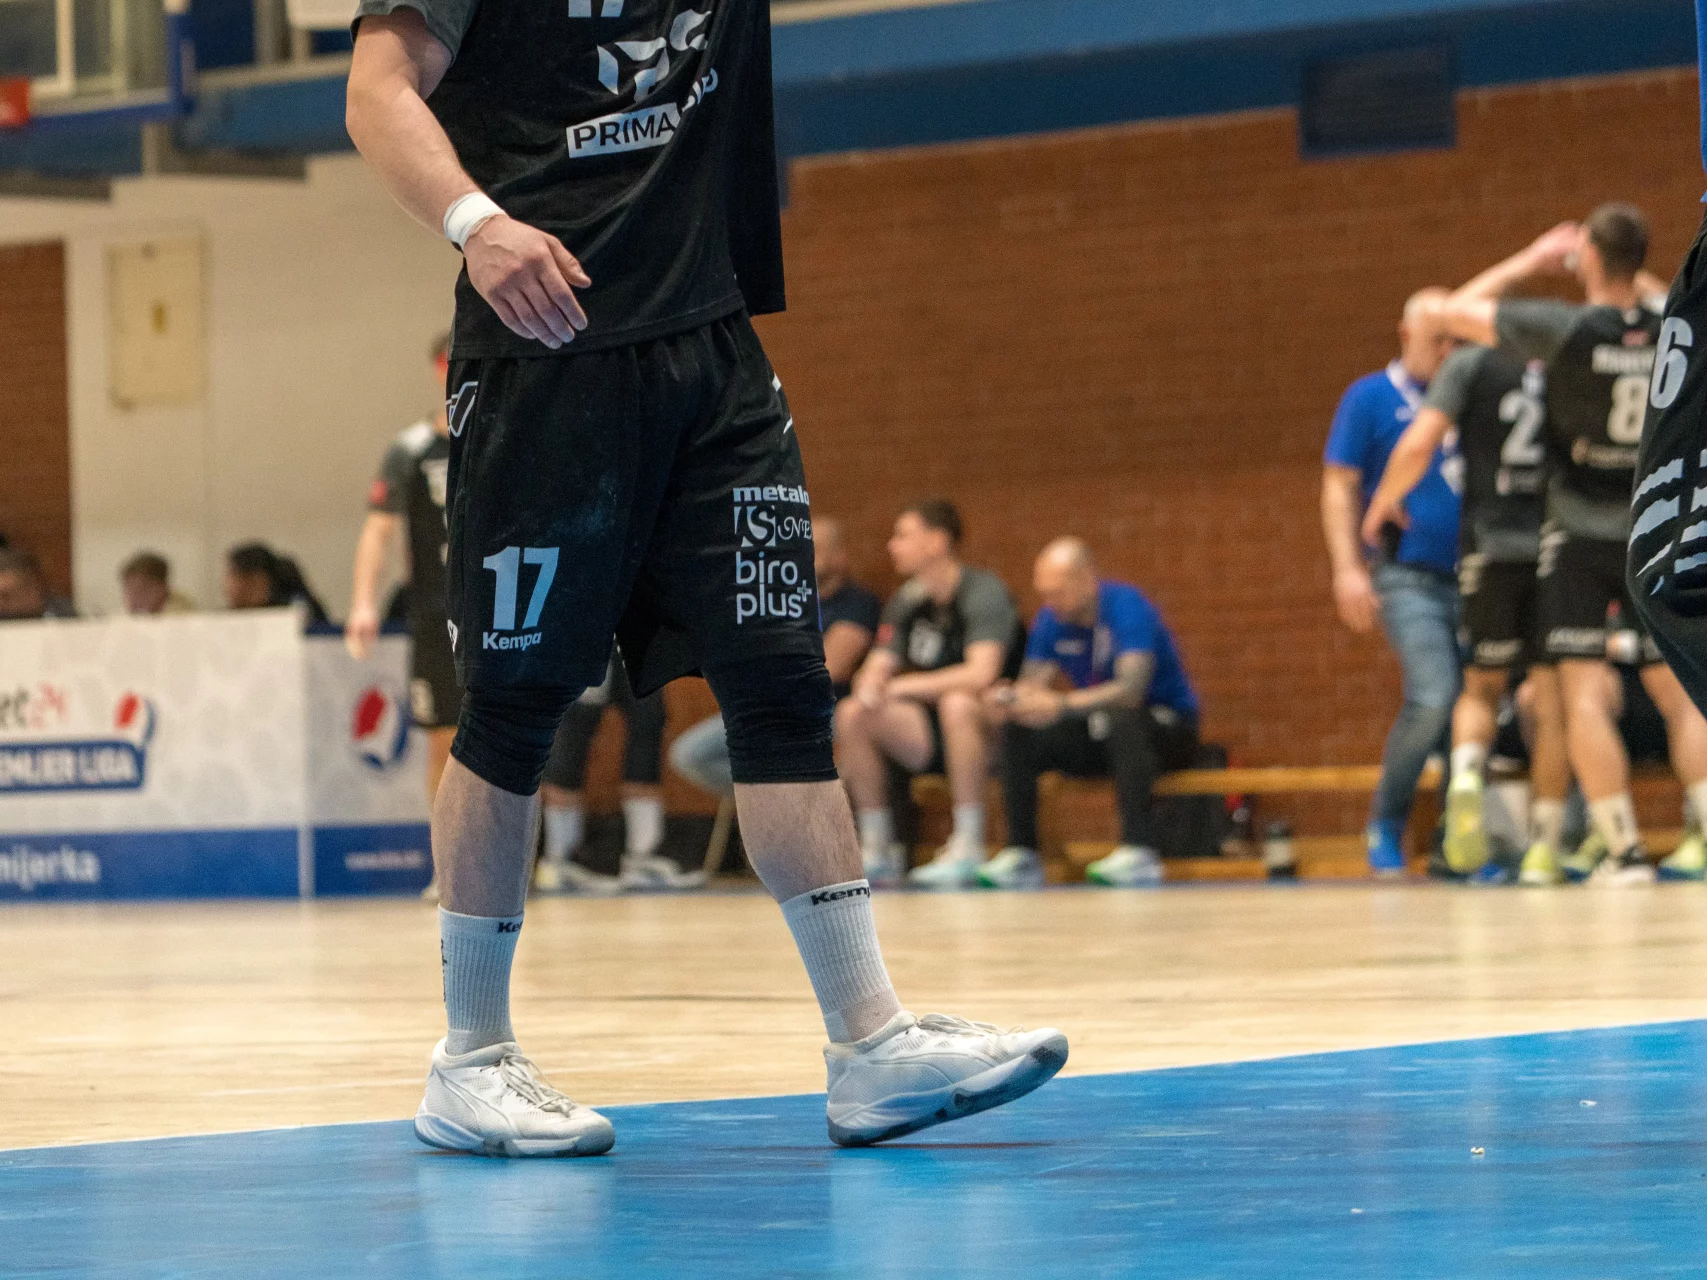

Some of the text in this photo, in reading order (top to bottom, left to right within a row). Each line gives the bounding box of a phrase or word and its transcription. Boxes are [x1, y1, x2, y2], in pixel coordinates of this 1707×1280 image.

[573, 112, 674, 150] PRIMA
[1650, 316, 1693, 409] 6
[735, 551, 798, 586] biro
[482, 545, 560, 631] 17
[482, 631, 542, 652] Kempa
[810, 886, 871, 906] Kem
